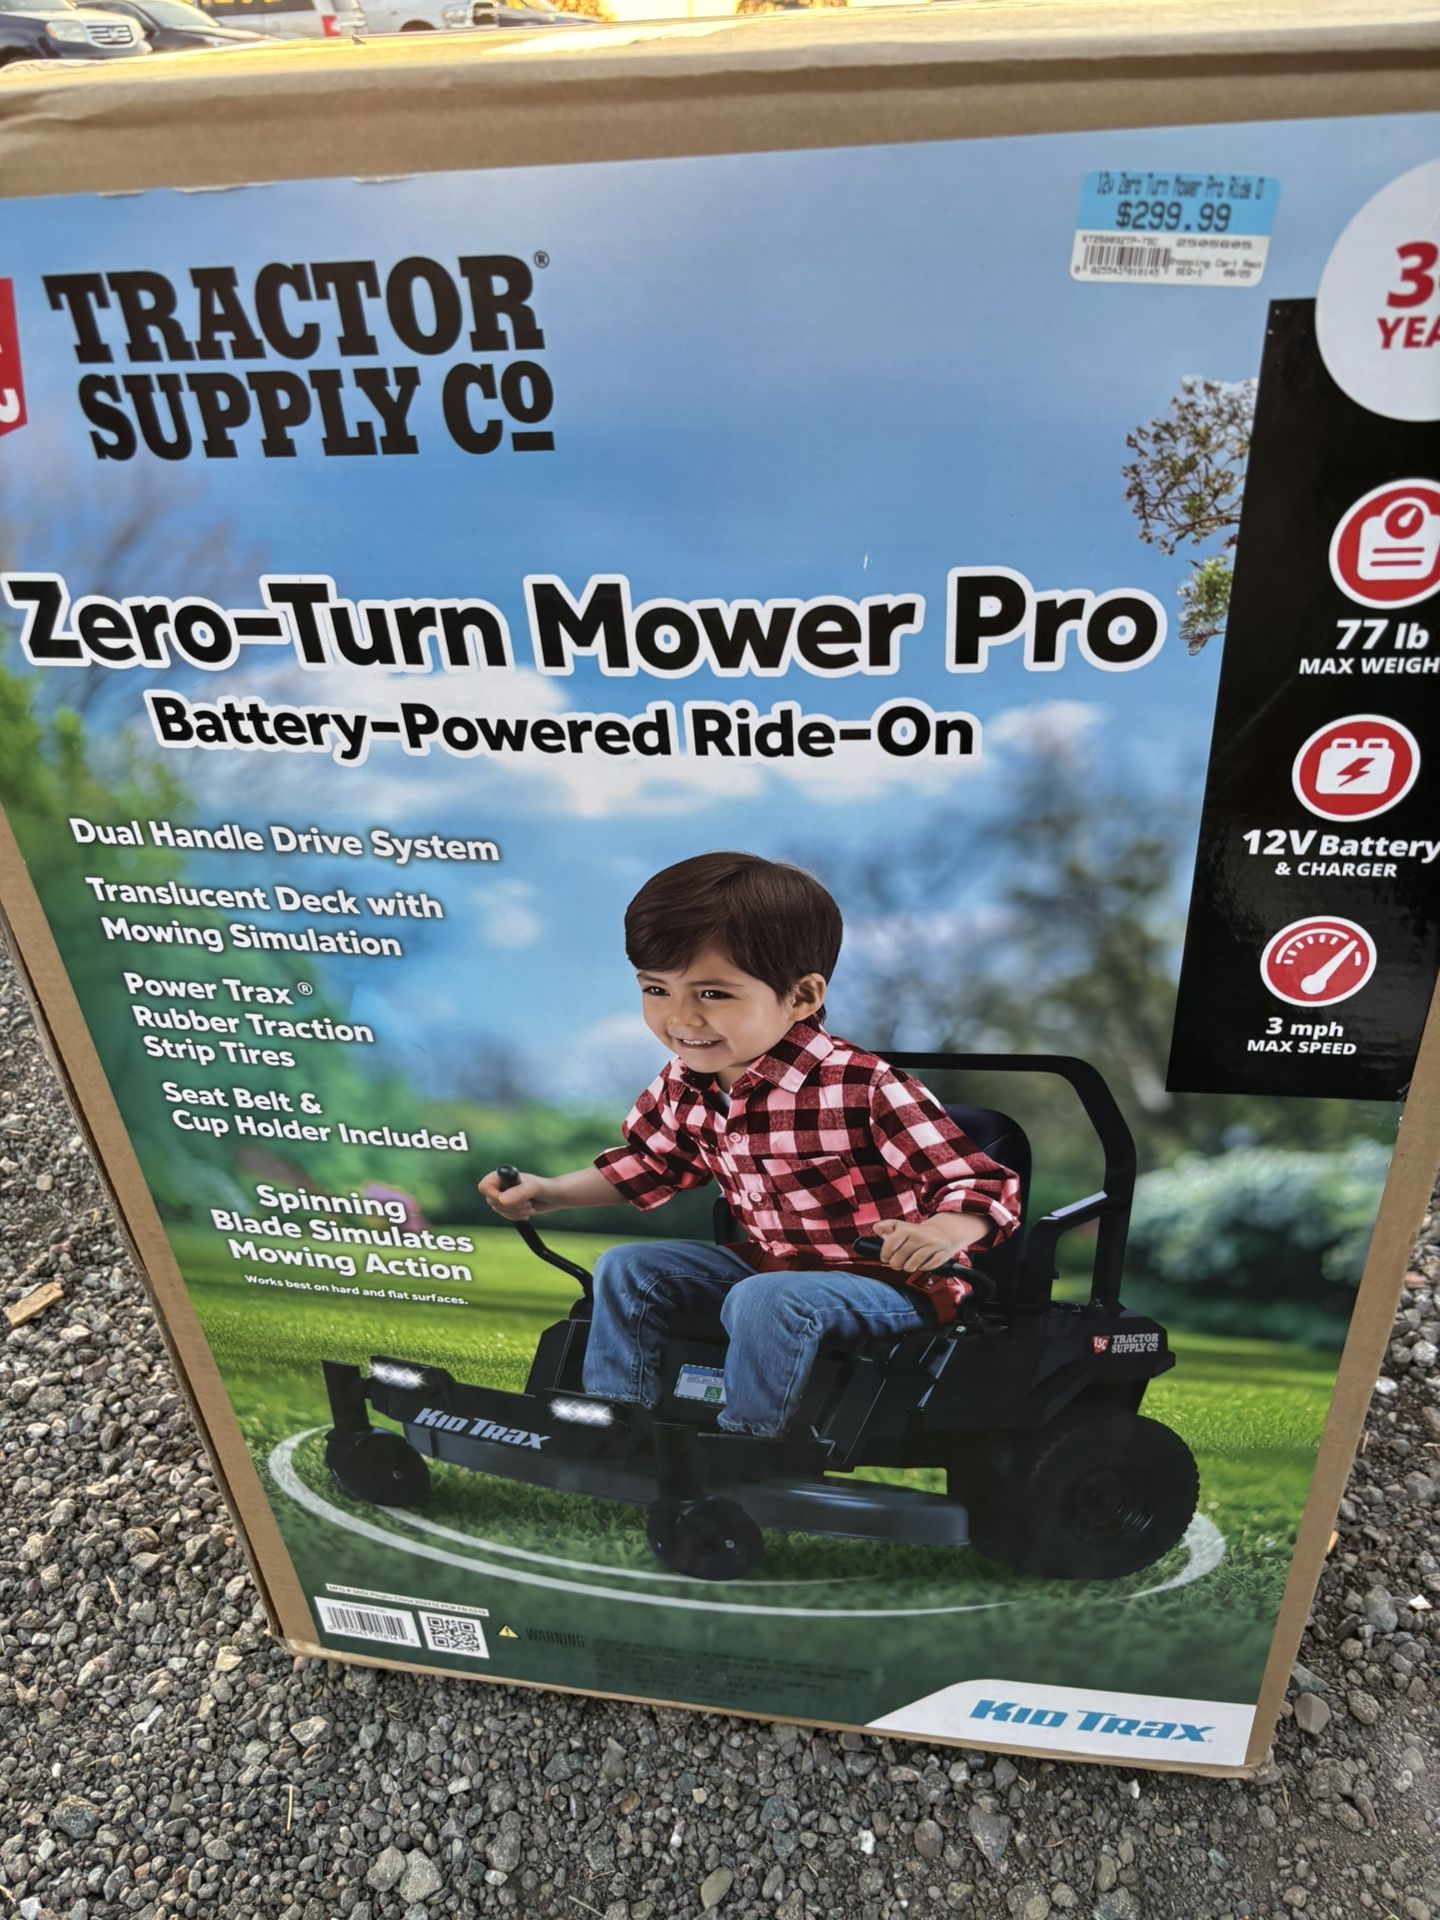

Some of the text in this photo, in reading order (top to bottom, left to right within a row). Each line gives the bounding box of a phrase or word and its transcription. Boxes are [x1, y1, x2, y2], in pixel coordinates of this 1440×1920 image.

[1118, 172, 1142, 195] Zero
[1147, 173, 1169, 196] Turn
[1173, 174, 1202, 197] Mower
[1206, 175, 1224, 198] Pro
[1228, 176, 1251, 199] Ride
[1116, 200, 1232, 232] $299.99
[78, 367, 419, 461] SUPPLY
[8, 576, 1158, 671] Zero-Turn Mower Pro
[1336, 619, 1429, 650] 77 lb
[1299, 658, 1354, 674] MAX
[151, 696, 974, 760] Battery-Powered Ride-On
[69, 817, 500, 864] Dual Handle Drive System
[1242, 830, 1440, 864] 12V Battery
[1274, 862, 1398, 878] & CHARGER
[85, 877, 443, 918] Translucent Deck with
[101, 917, 402, 956] Mowing Simulation
[124, 972, 216, 1000] Power
[132, 1006, 374, 1042] Rubber Traction
[1266, 1018, 1344, 1041] 3 mph
[143, 1036, 296, 1068] Strip Tires
[1247, 1040, 1356, 1056] MAX SPEED
[162, 1082, 323, 1114] Seat Belt &
[172, 1110, 468, 1151] Cup Holder Included
[256, 1184, 407, 1223] Spinning
[210, 1209, 474, 1253] Blade Simulates
[228, 1238, 472, 1281] Mowing Action
[244, 1274, 468, 1304] Works best on hard and flat surfaces.
[1112, 1333, 1158, 1344] TRACTOR
[1112, 1343, 1146, 1354] SUPPLY
